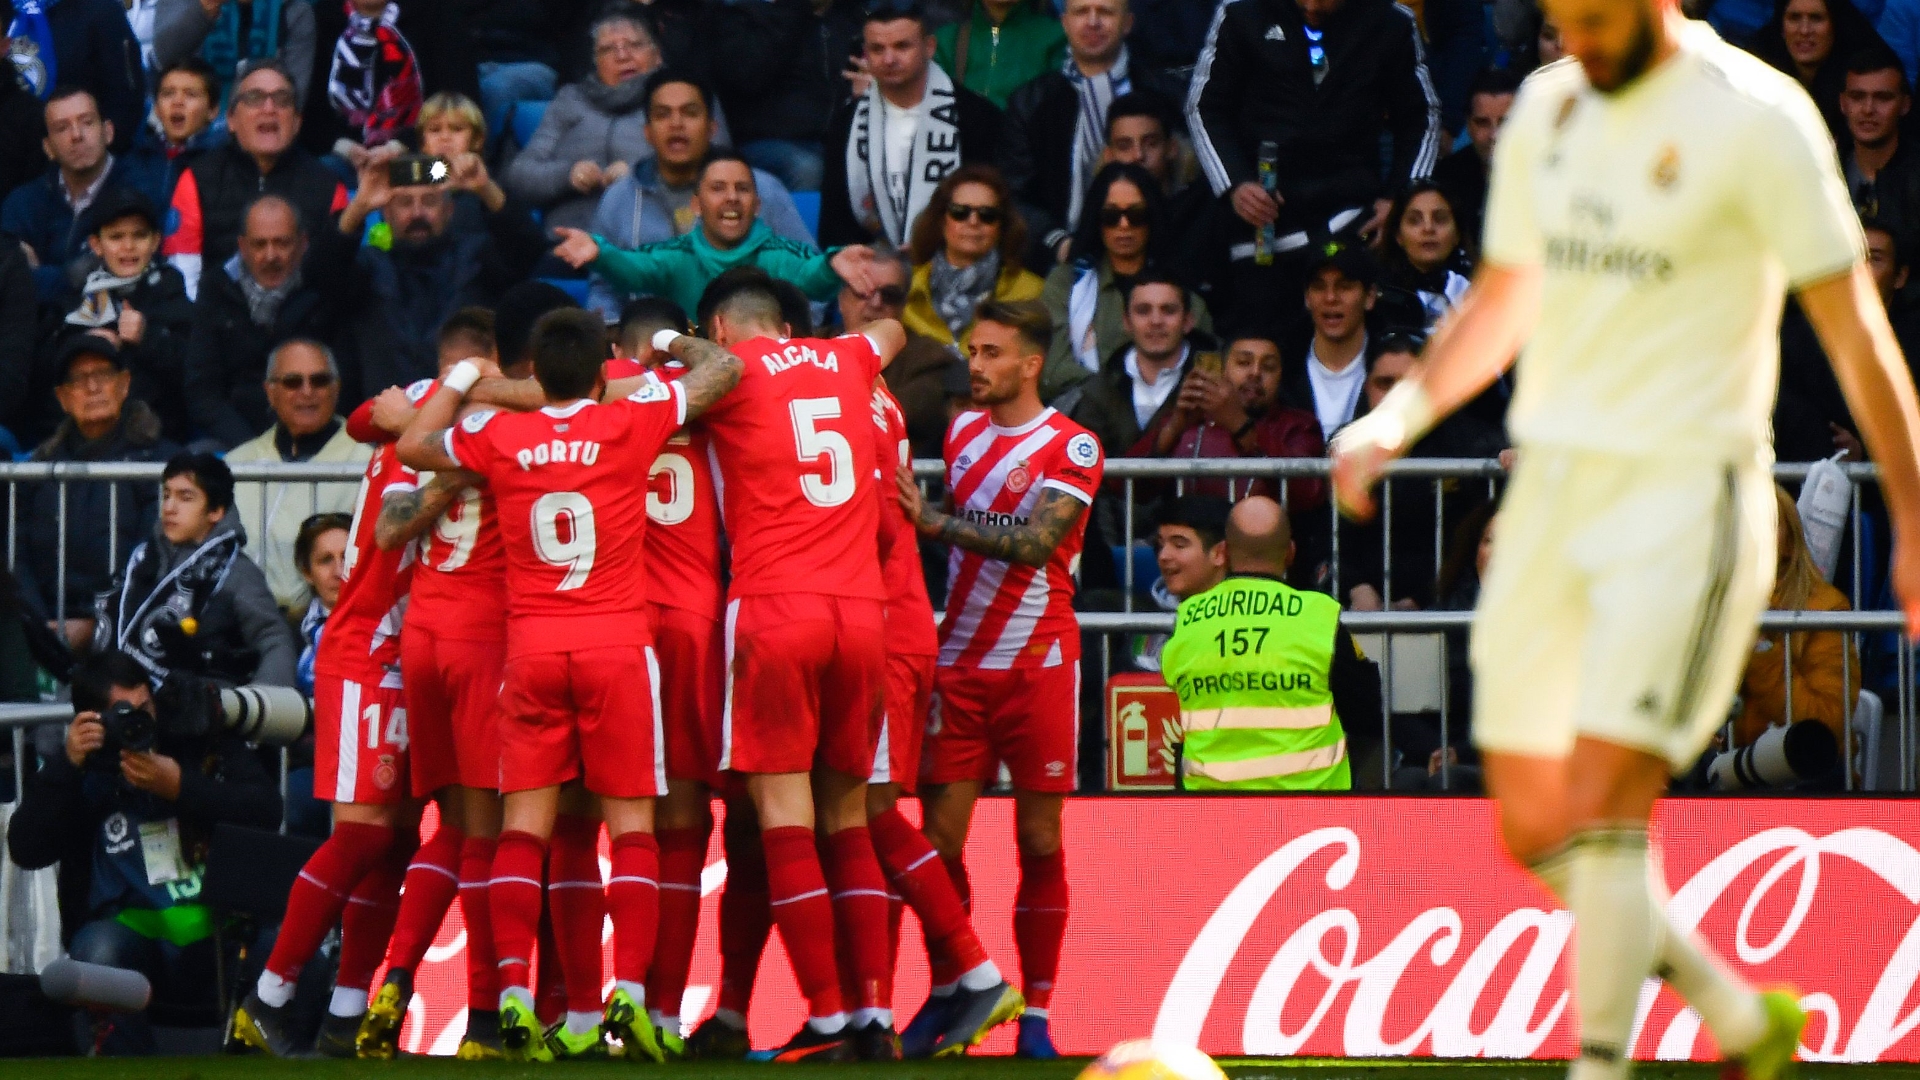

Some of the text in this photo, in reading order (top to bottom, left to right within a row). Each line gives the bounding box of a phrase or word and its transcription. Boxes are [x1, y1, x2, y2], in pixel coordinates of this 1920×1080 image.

[517, 439, 600, 471] PORTU
[788, 396, 856, 507] 5
[530, 491, 596, 591] 9
[1183, 590, 1303, 627] SEGURIDAD
[1214, 627, 1270, 658] 157
[1192, 671, 1312, 696] PROSEGUR
[363, 703, 410, 753] 14
